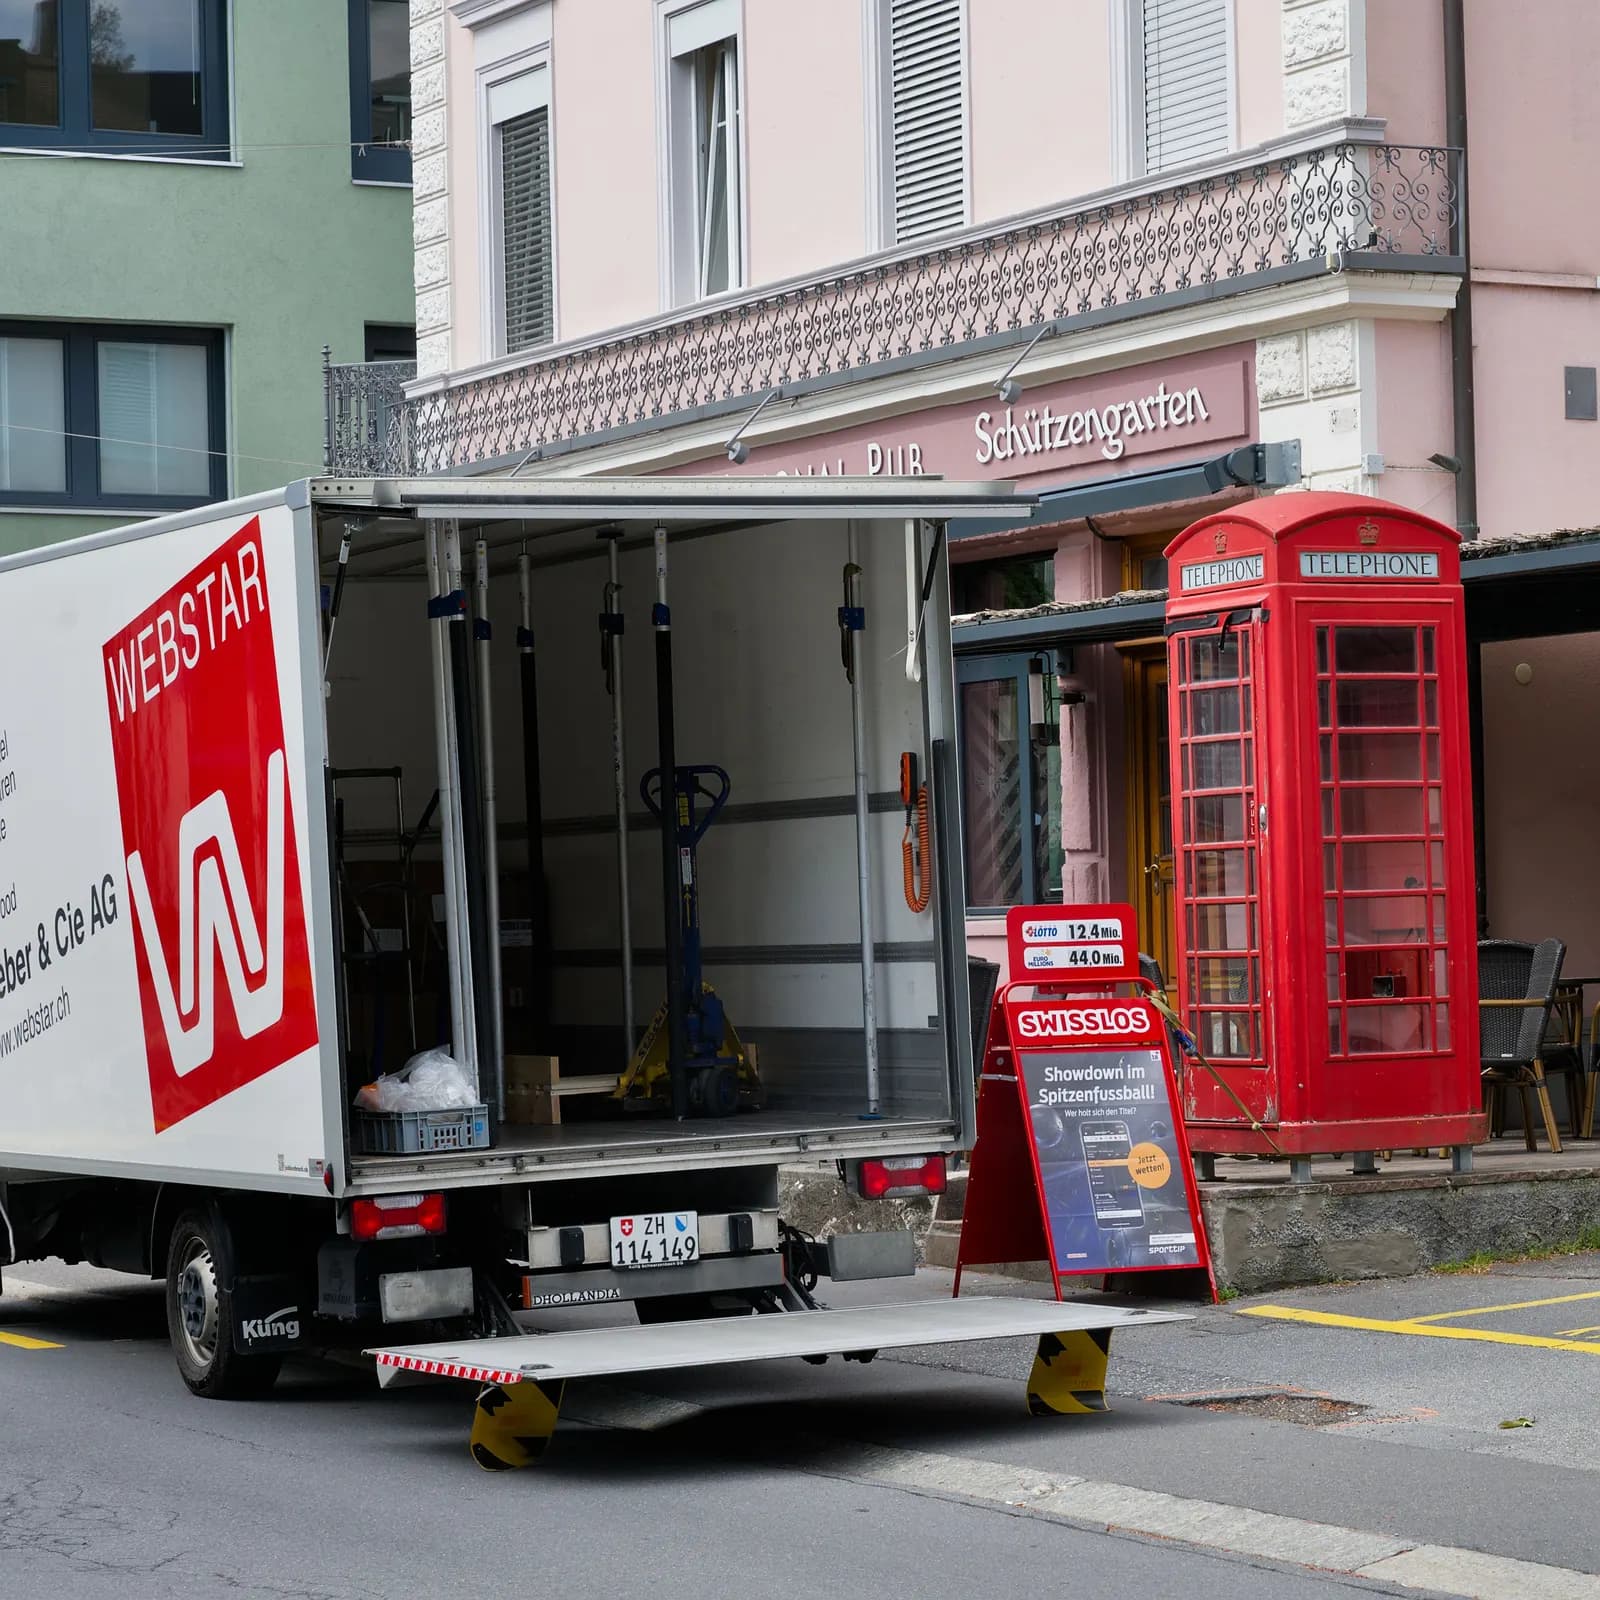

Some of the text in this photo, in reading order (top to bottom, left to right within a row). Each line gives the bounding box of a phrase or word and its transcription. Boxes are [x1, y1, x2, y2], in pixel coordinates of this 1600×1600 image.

[974, 382, 1210, 463] Schützengarten
[1185, 555, 1263, 588] TELEPHONE
[1304, 553, 1433, 575] TELEPHONE
[107, 540, 265, 723] WEBSTAR
[37, 922, 52, 970] &
[55, 902, 85, 957] Cie
[91, 873, 118, 936] AG
[1033, 926, 1058, 938] LOTTO
[1101, 927, 1121, 938] Mio.
[1103, 953, 1122, 965] Mio.
[1020, 1010, 1148, 1035] SWISSLOS
[1044, 1064, 1145, 1082] Showdown im
[1038, 1085, 1155, 1106] Spitzenfussball!
[1064, 1107, 1137, 1118] Wer holt sich den Titel?
[1135, 1163, 1165, 1175] wetten!
[1137, 1154, 1157, 1165] Jetzt
[643, 1215, 665, 1236] ZH
[615, 1235, 696, 1264] 114 149
[532, 1287, 621, 1306] DHOLLANDIA
[241, 1317, 300, 1339] Küng
